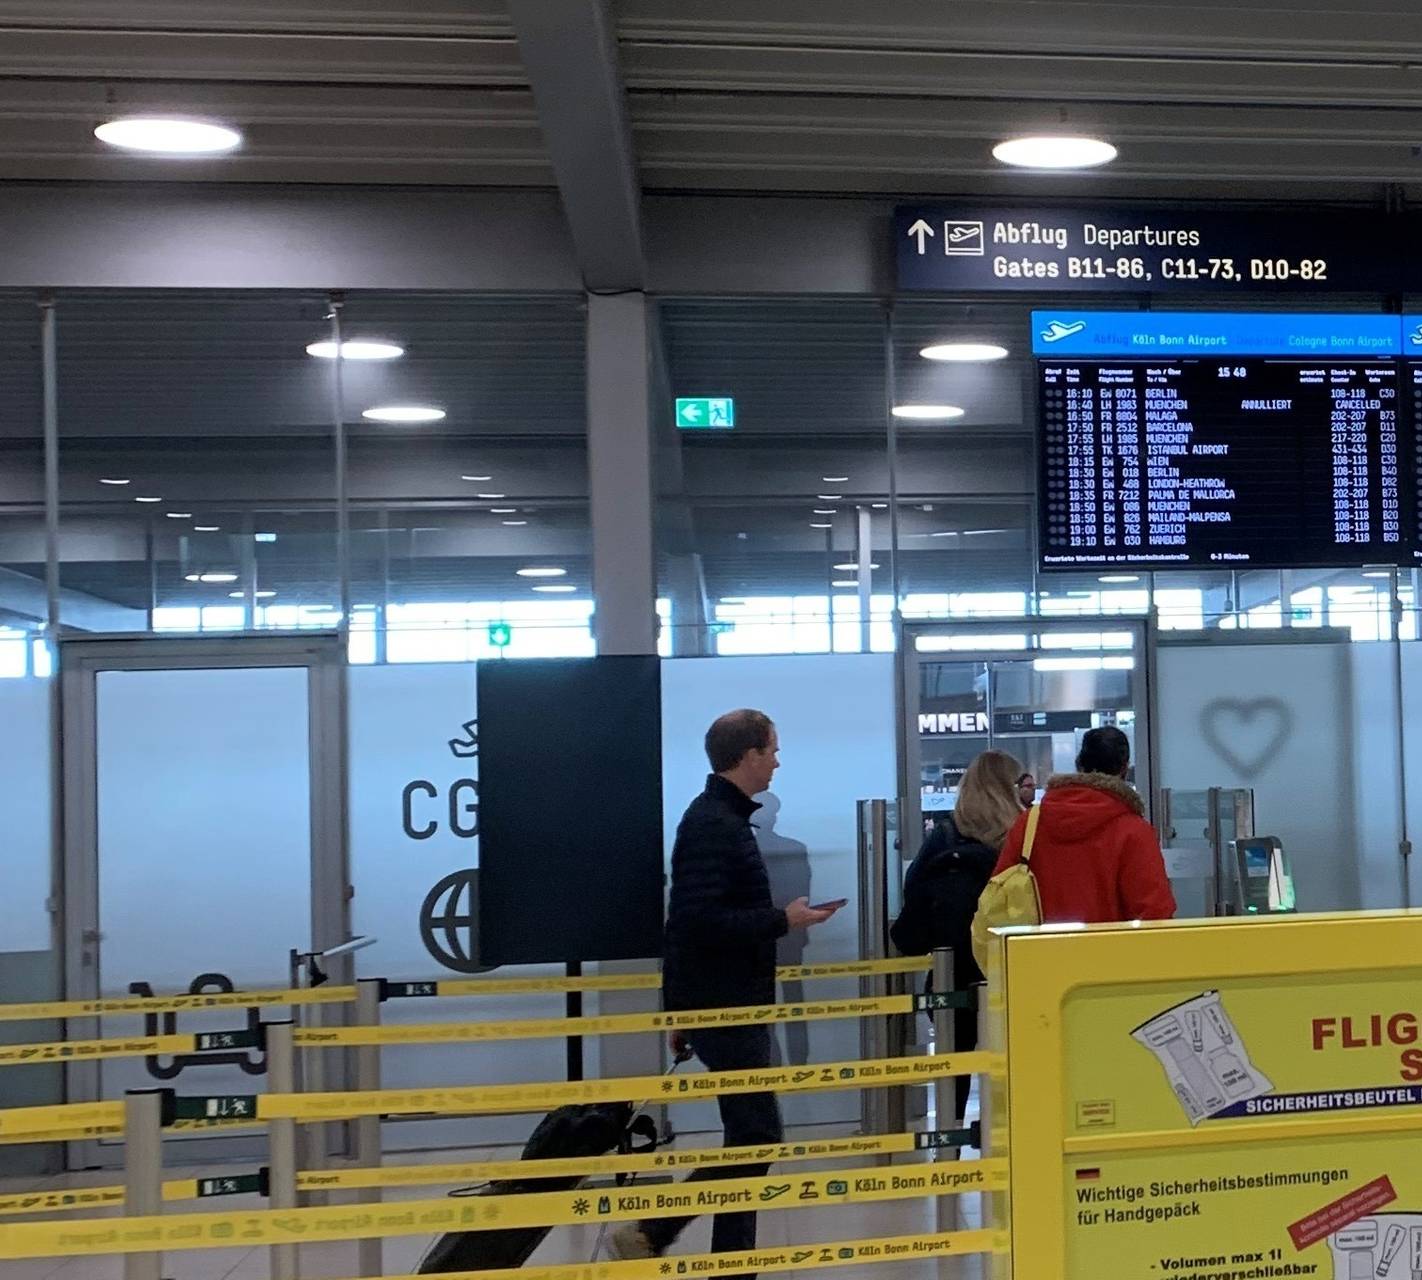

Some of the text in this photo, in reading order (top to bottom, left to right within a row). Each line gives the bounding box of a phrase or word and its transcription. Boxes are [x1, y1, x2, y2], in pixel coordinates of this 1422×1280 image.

[993, 222, 1200, 249] Abflug Departures
[993, 257, 1327, 281] Gates B11-86, C11-73, D10-82
[1133, 335, 1155, 345] Köln
[1160, 335, 1183, 345] Bonn
[1188, 334, 1227, 346] Airport
[1288, 335, 1327, 347] Cologne
[1331, 336, 1354, 346] Bonn
[1358, 336, 1393, 347] Airport
[1218, 367, 1230, 377] 15
[1067, 389, 1177, 398] 16:10 BERLIN
[1067, 400, 1380, 409] 16:40 MUENCHEN ANNULLIERT CANCELLED
[1067, 411, 1177, 421] 16:50 MALAGA
[1068, 423, 1193, 432] 17:50 BARCELONA
[1068, 434, 1188, 443] 17:55 MUENCHEN
[1068, 445, 1228, 455] 17:55 ISTANBUL AIRPORT
[1068, 457, 1094, 466] 18:15
[1069, 468, 1179, 477] 18:30 BERLIN
[1069, 479, 1225, 489] 18:30 LONDON-HEATHROW
[1070, 490, 1235, 500] 18:35 PALMA DE MALLORCA
[1070, 502, 1190, 511] 18:50 MUENCHEN
[1070, 512, 1230, 523] 18:50 MAILAND-MALPENSA
[1071, 524, 1185, 534] 19:00 ZUERICH
[1071, 535, 1186, 546] 19:10 HAMBURG
[859, 1060, 951, 1077] Köln Bonn Airport
[692, 1073, 787, 1089] Köln Bonn Airport
[1246, 1089, 1416, 1114] SICHERHEITSBEUTEL
[855, 1170, 984, 1192] Köln Bonn Airport
[1076, 1169, 1348, 1204] Wichtige Sicherheitsbestimmungen
[618, 1189, 752, 1211] Köln Bonn Airport
[1078, 1202, 1200, 1226] für Handgepäck
[858, 1239, 950, 1257] Köln Bonn Airport
[691, 1254, 786, 1272] Köln Bonn Airport
[1161, 1256, 1225, 1270] Volumen
[1232, 1252, 1263, 1263] max
